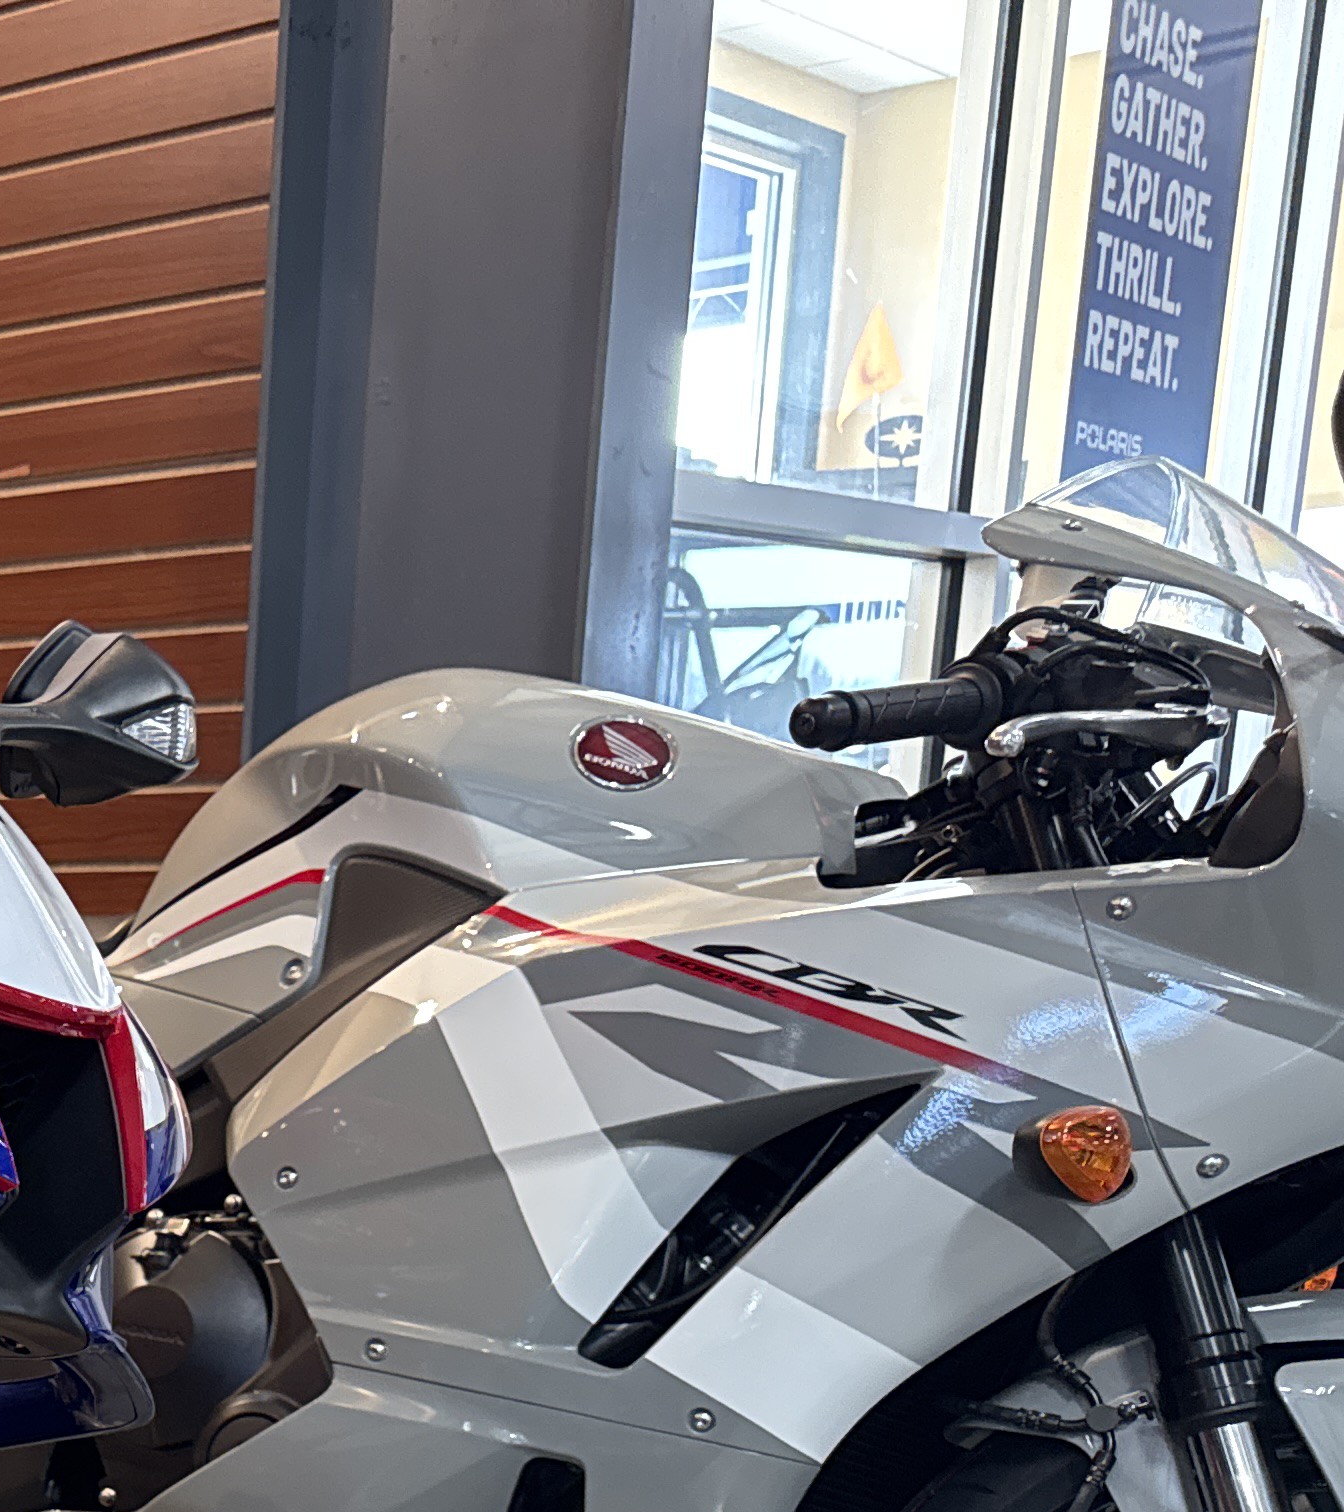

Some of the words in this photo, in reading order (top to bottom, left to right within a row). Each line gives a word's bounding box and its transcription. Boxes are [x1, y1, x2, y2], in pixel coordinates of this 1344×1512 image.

[1119, 0, 1204, 90] CHASE.
[1111, 73, 1208, 172] GATHER.
[1101, 151, 1213, 252] EXPLORE.
[1096, 230, 1182, 318] THRILL.
[1083, 308, 1180, 393] REPEAT.
[1075, 420, 1143, 457] POLARIS
[693, 944, 968, 1042] CBR
